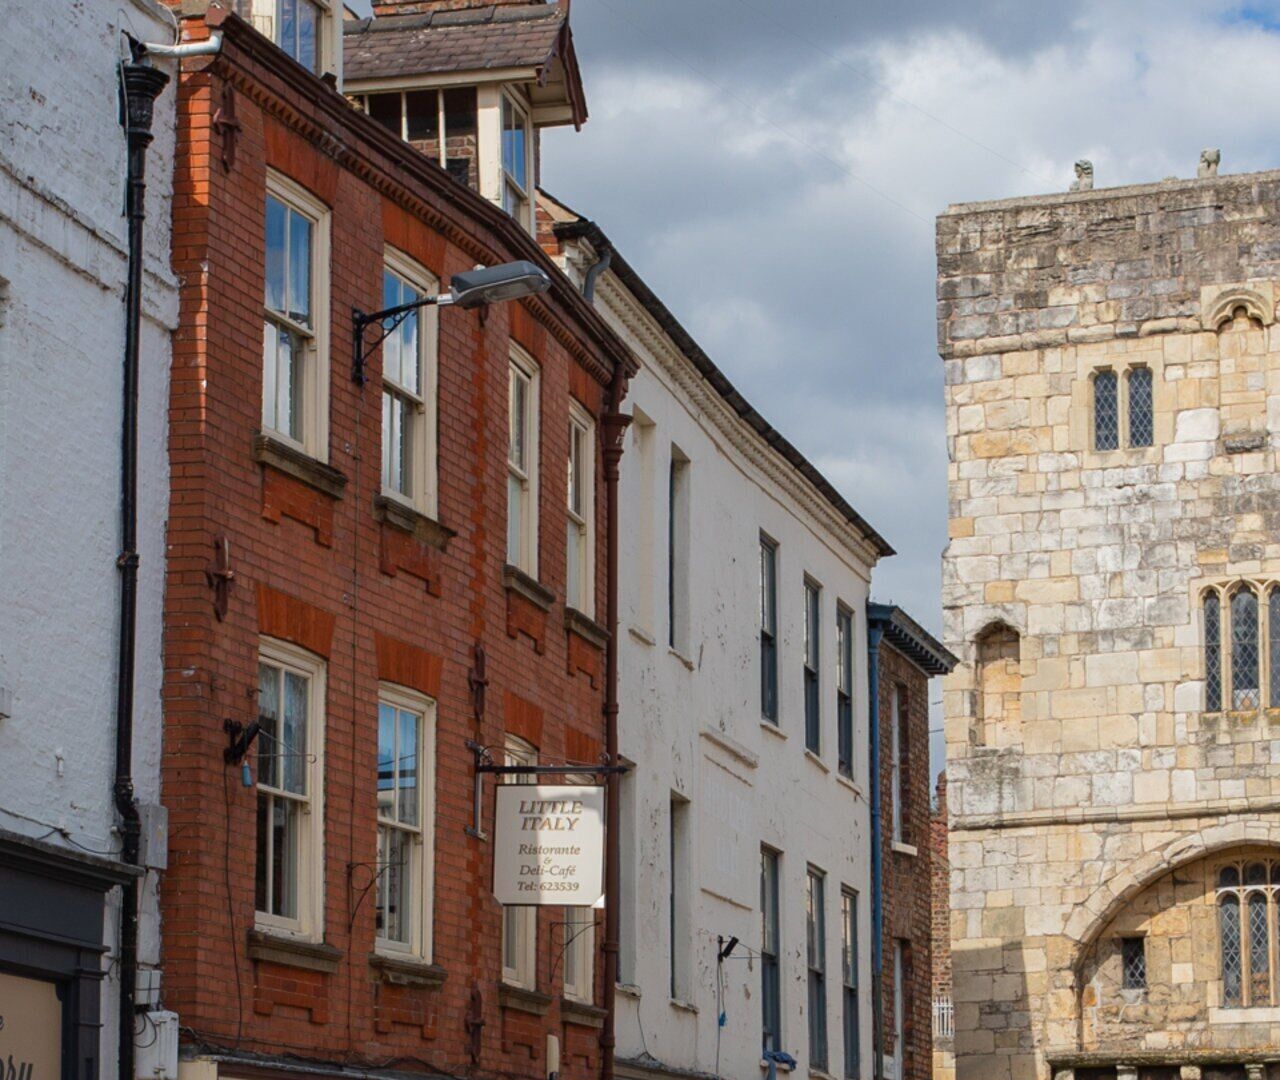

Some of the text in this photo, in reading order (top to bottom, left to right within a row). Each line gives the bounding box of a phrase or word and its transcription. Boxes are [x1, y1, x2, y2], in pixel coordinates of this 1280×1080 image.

[518, 800, 584, 814] LITTLE
[521, 817, 580, 831] ITALY
[518, 843, 581, 856] Ristorante
[519, 865, 577, 879] Deli-Café
[517, 881, 580, 891] Tel: 623539
